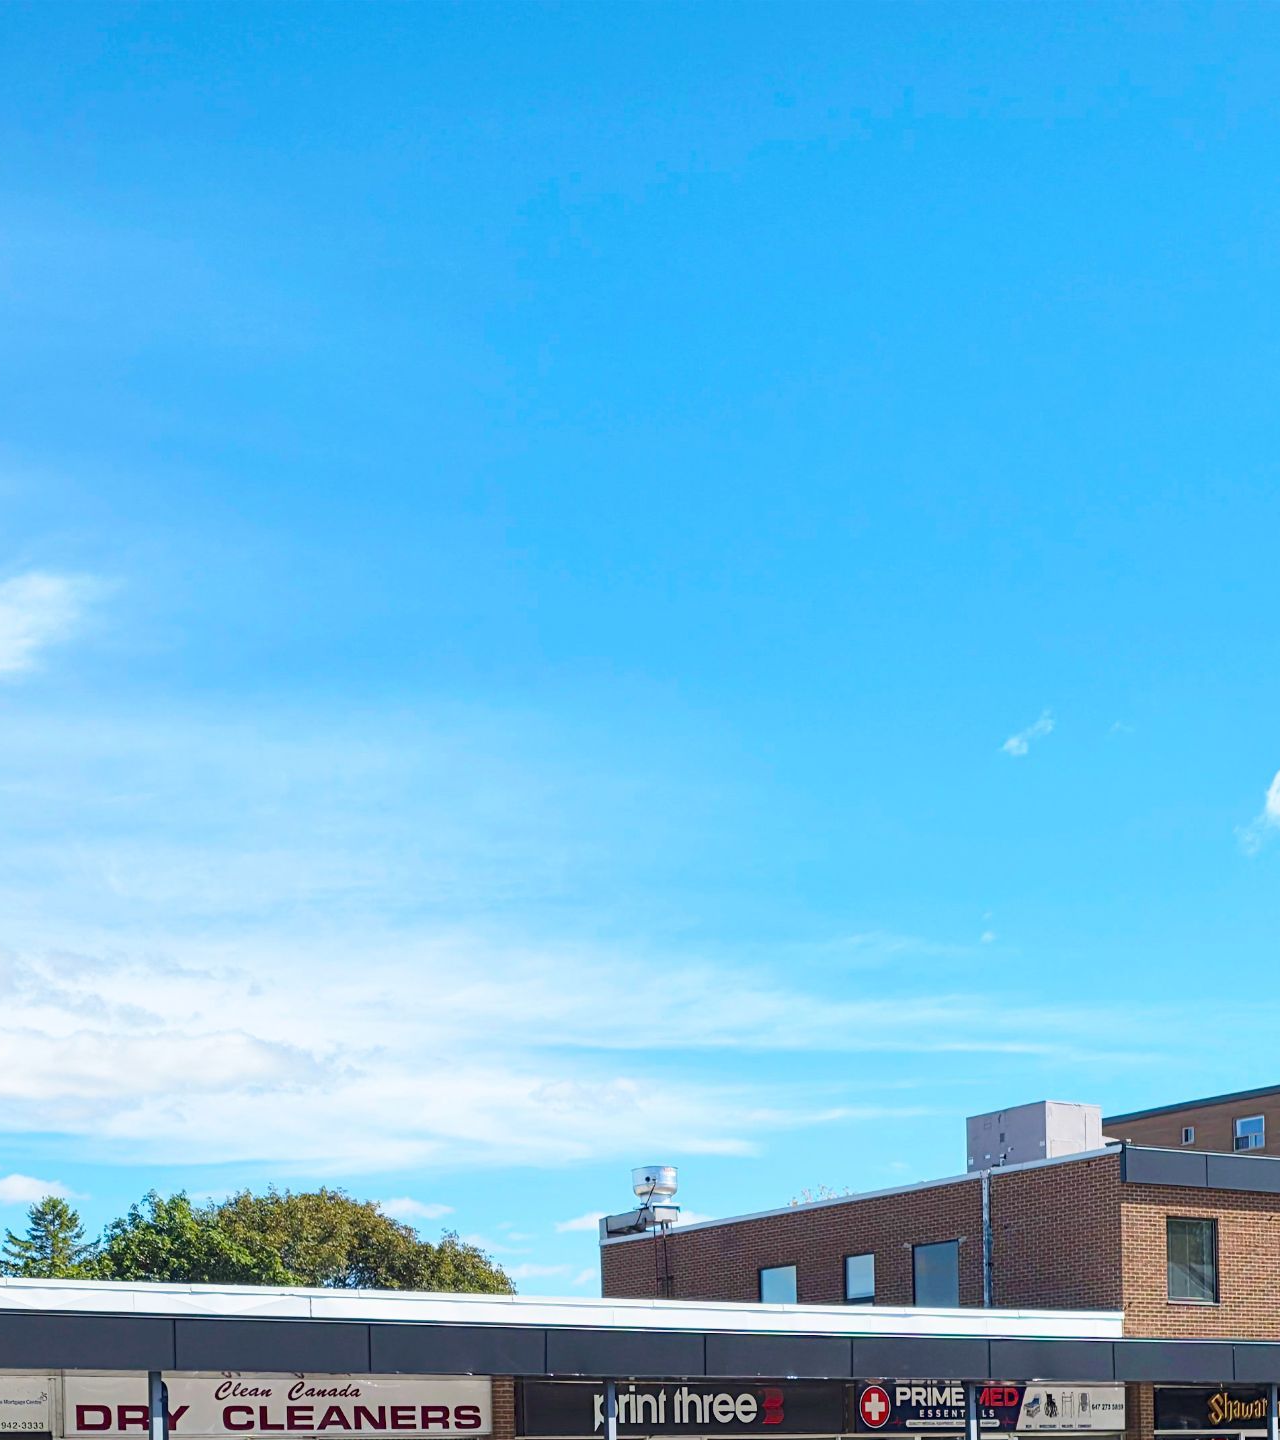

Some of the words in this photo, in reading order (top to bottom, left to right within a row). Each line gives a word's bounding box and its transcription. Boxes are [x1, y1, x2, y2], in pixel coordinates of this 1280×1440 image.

[214, 1381, 272, 1400] Clean
[288, 1380, 362, 1400] Canada
[896, 1387, 965, 1406] PRIME
[76, 1405, 190, 1431] DRY
[223, 1405, 481, 1431] CLEANERS
[594, 1385, 666, 1431] print
[674, 1387, 758, 1423] three
[920, 1409, 995, 1418] ESSENTLS
